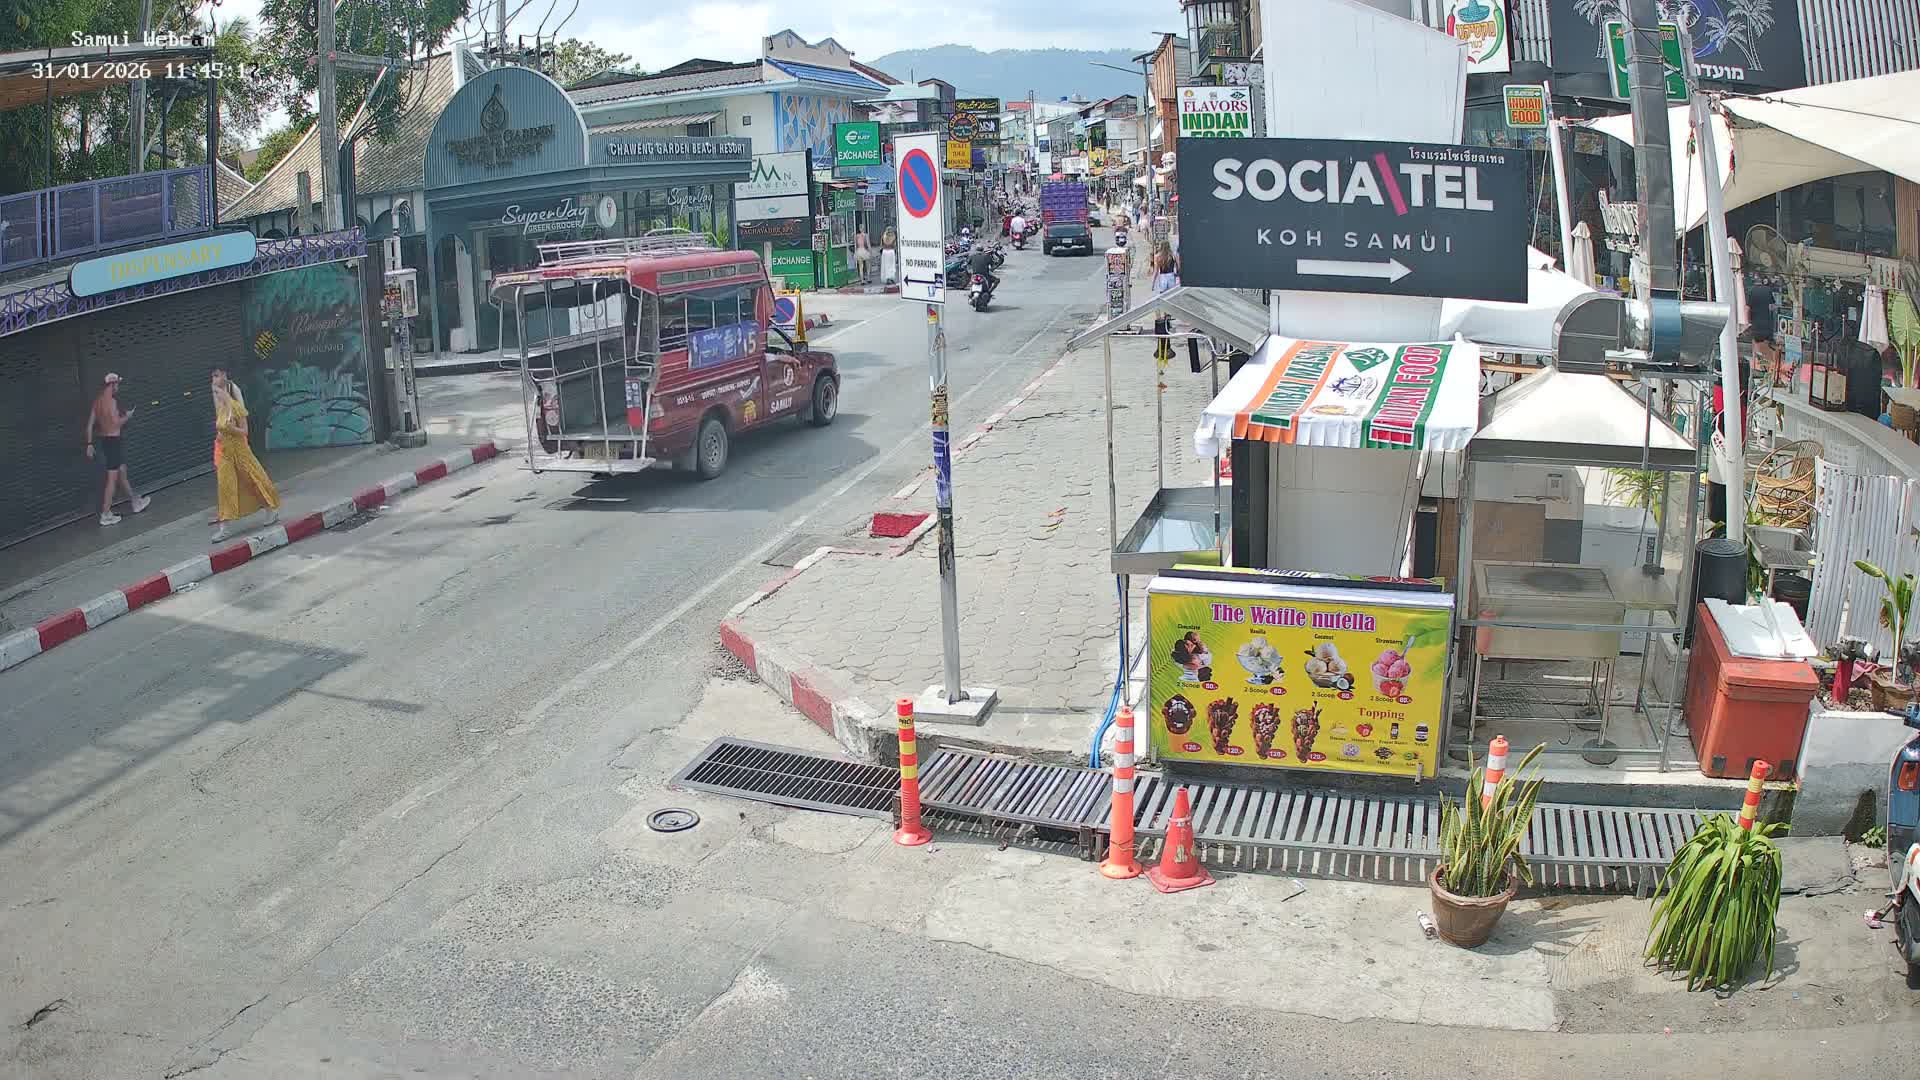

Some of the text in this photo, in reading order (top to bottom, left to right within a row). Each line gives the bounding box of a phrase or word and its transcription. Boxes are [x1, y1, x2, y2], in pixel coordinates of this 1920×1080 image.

[1184, 100, 1248, 112] FLAVORS
[1508, 97, 1541, 109] INDIAN
[1182, 113, 1248, 129] INDIAN
[1511, 110, 1540, 123] FOOD
[610, 142, 745, 155] CHAWENG GARDEN BEACH RESORT
[838, 150, 878, 160] EXCHANGE
[1408, 146, 1505, 164] โรงแรมโซเชียลเทล
[502, 198, 589, 235] SuperJay
[528, 221, 582, 232] GREEN GROCER
[1257, 229, 1451, 253] KOH SAMUI
[110, 243, 224, 283] DISPENSARY
[773, 256, 811, 266] EXCHANGE
[905, 258, 937, 269] NO PARKING
[1369, 345, 1441, 446] INDIAN FOOD
[1212, 603, 1376, 632] The Waffle nutella
[1358, 708, 1405, 720] Topping
